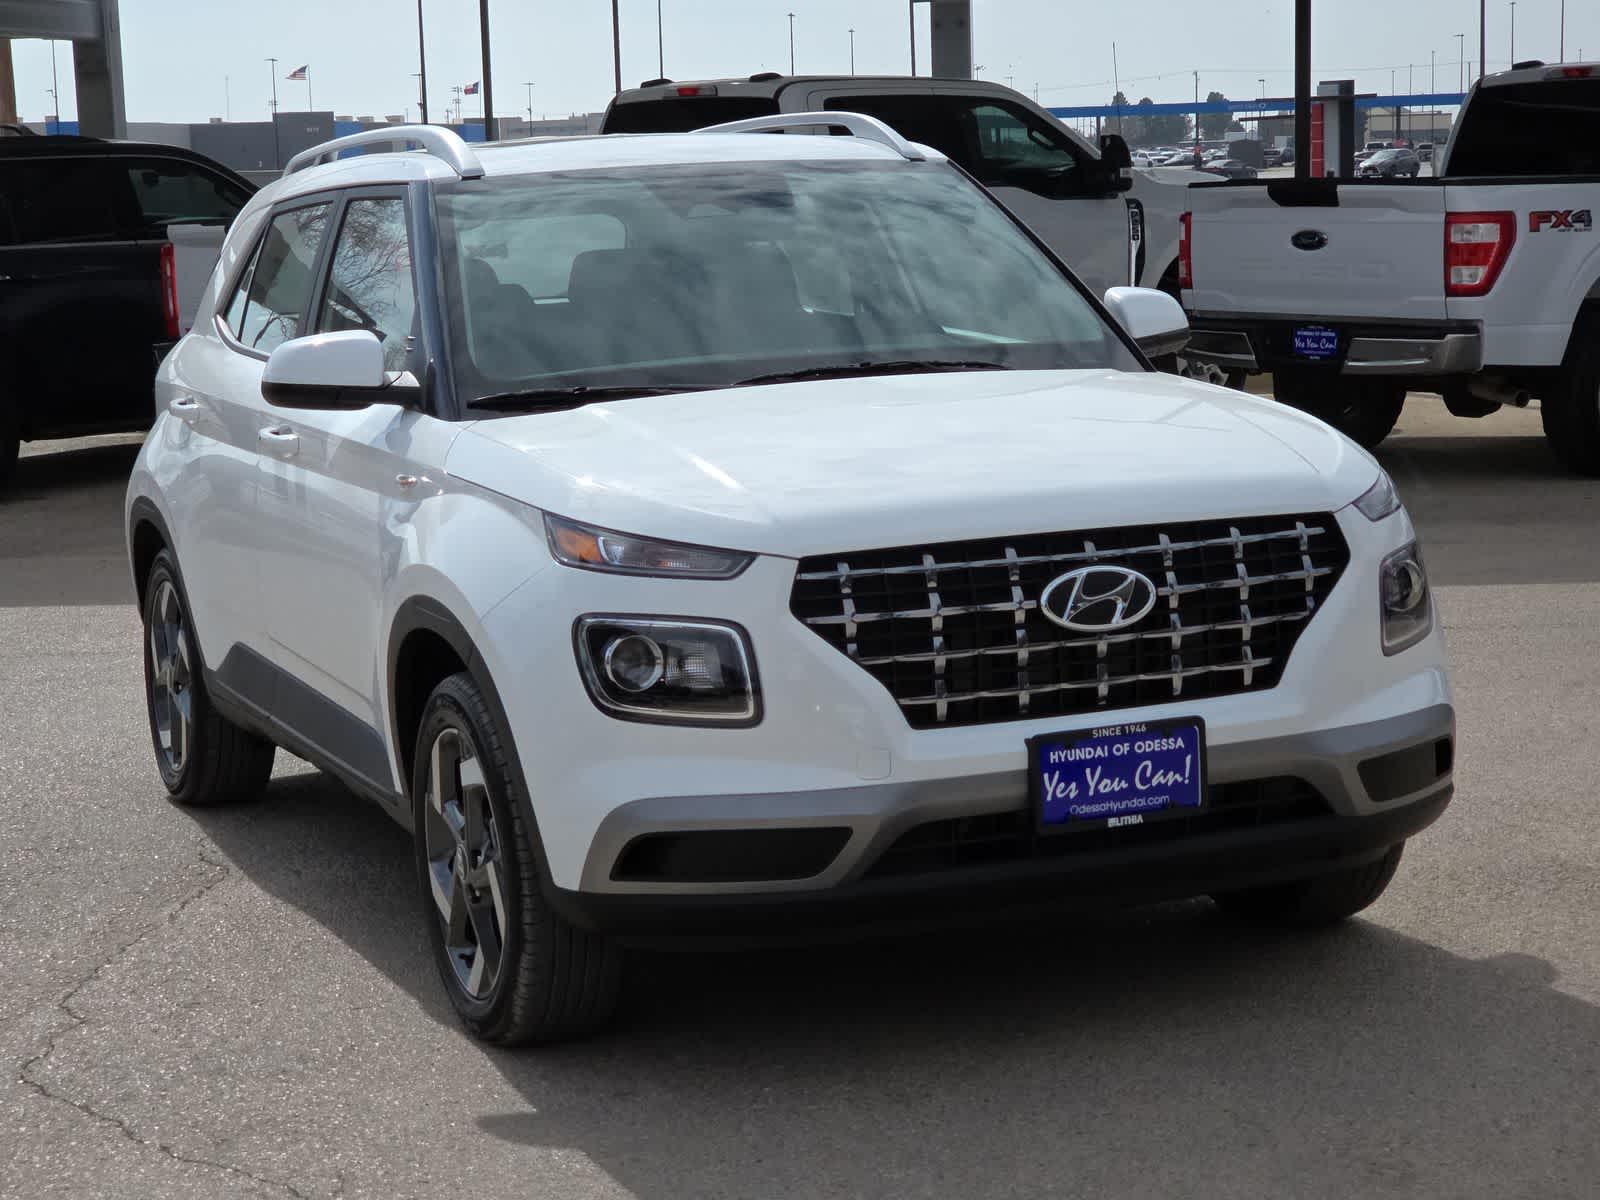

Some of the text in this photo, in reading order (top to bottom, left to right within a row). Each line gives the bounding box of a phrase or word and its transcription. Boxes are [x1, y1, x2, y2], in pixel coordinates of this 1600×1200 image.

[1528, 209, 1592, 232] FX4
[1092, 723, 1147, 738] SINCE 1946
[1050, 737, 1185, 763] HYUNDAI OF ODESSA
[1042, 754, 1192, 801] Yes You Can!
[1069, 794, 1170, 816] OdessaHyundai.com
